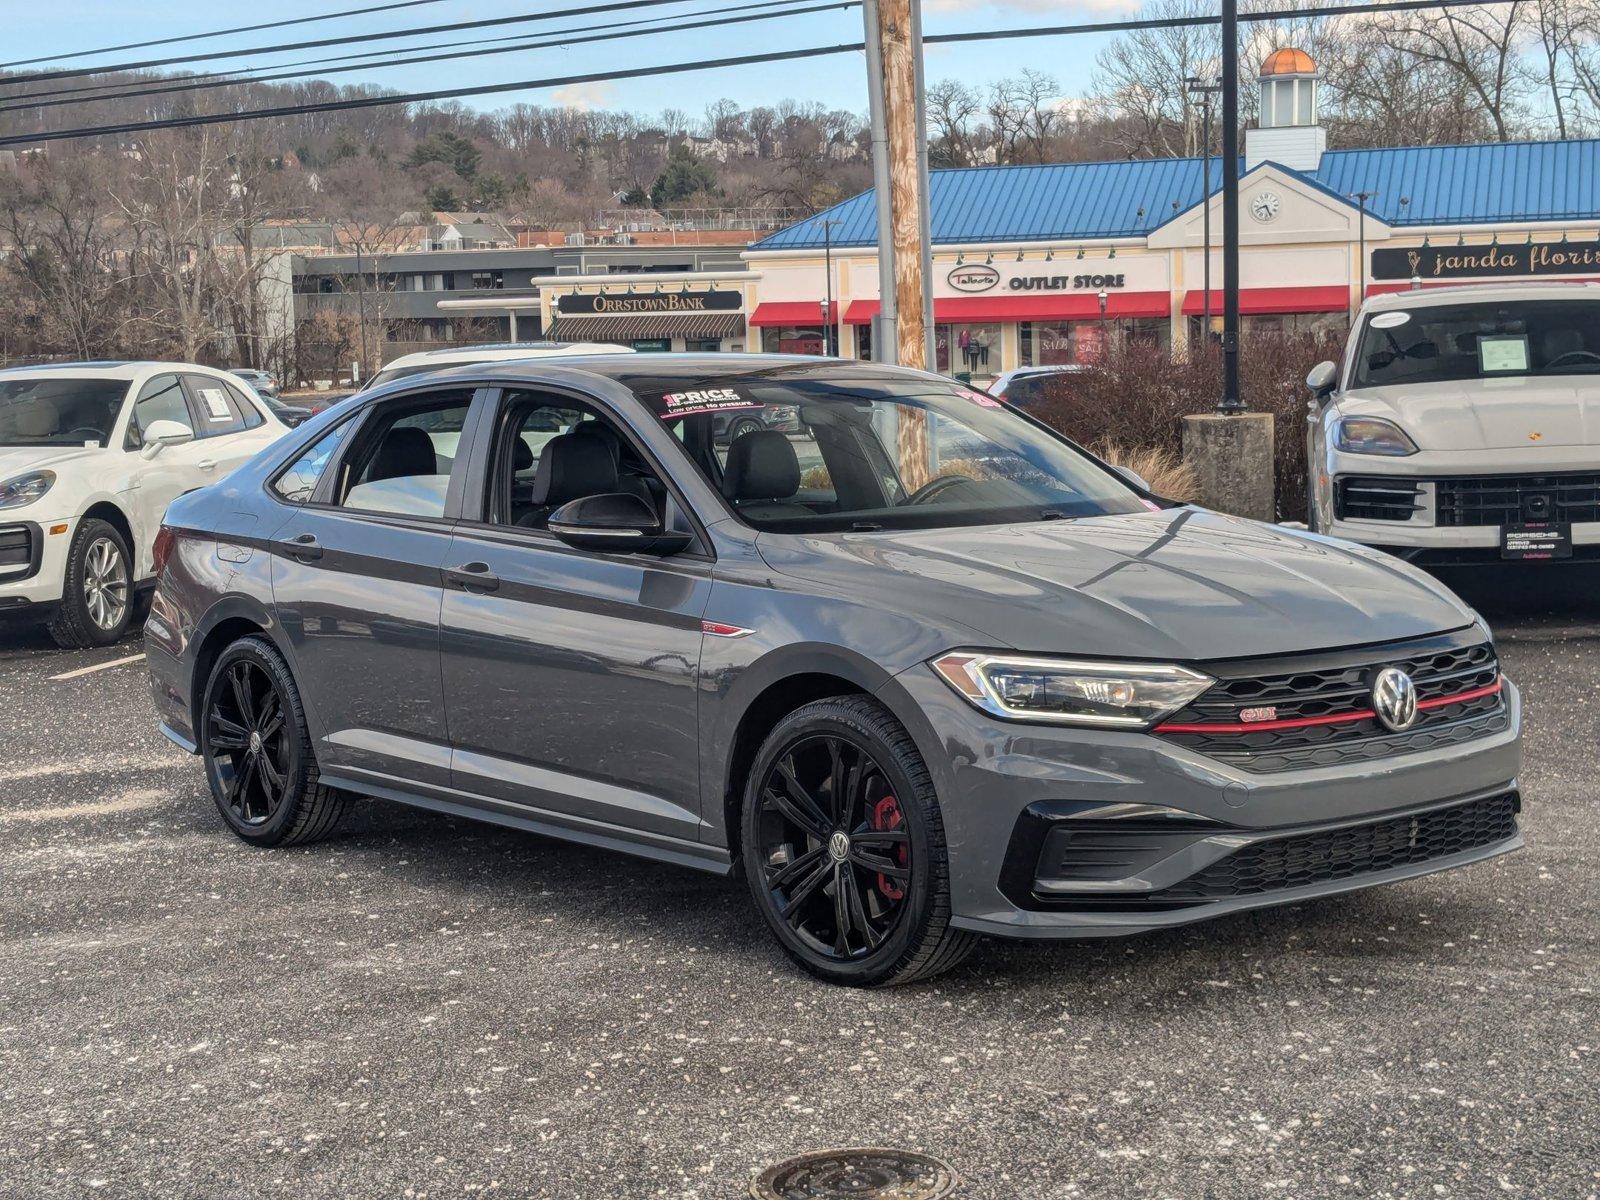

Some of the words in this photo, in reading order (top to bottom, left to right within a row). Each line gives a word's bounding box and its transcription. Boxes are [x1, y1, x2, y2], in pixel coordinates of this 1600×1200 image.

[1433, 248, 1517, 275] janda
[1009, 276, 1069, 290] OUTLET
[1073, 274, 1125, 289] STORE
